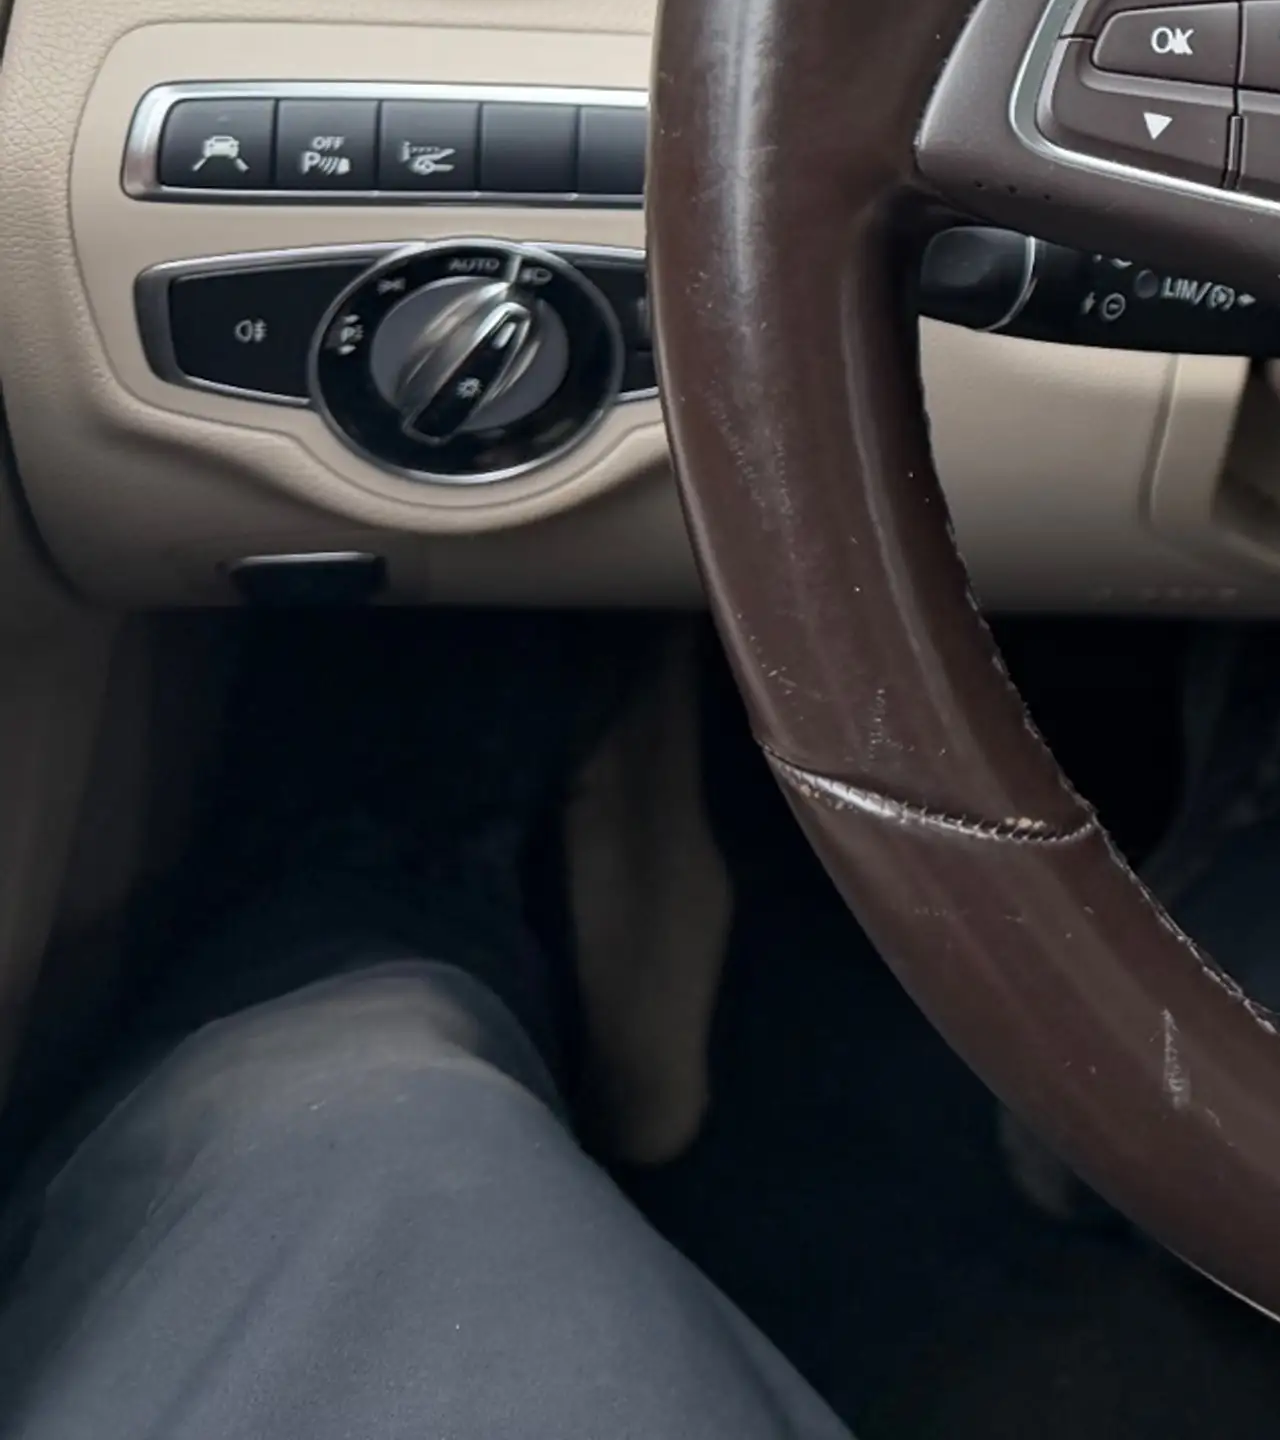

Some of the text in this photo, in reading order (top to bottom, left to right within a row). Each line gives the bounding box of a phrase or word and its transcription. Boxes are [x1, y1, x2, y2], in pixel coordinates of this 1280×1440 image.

[1150, 26, 1195, 56] OK
[311, 135, 345, 151] OFF
[449, 257, 500, 272] AUTO
